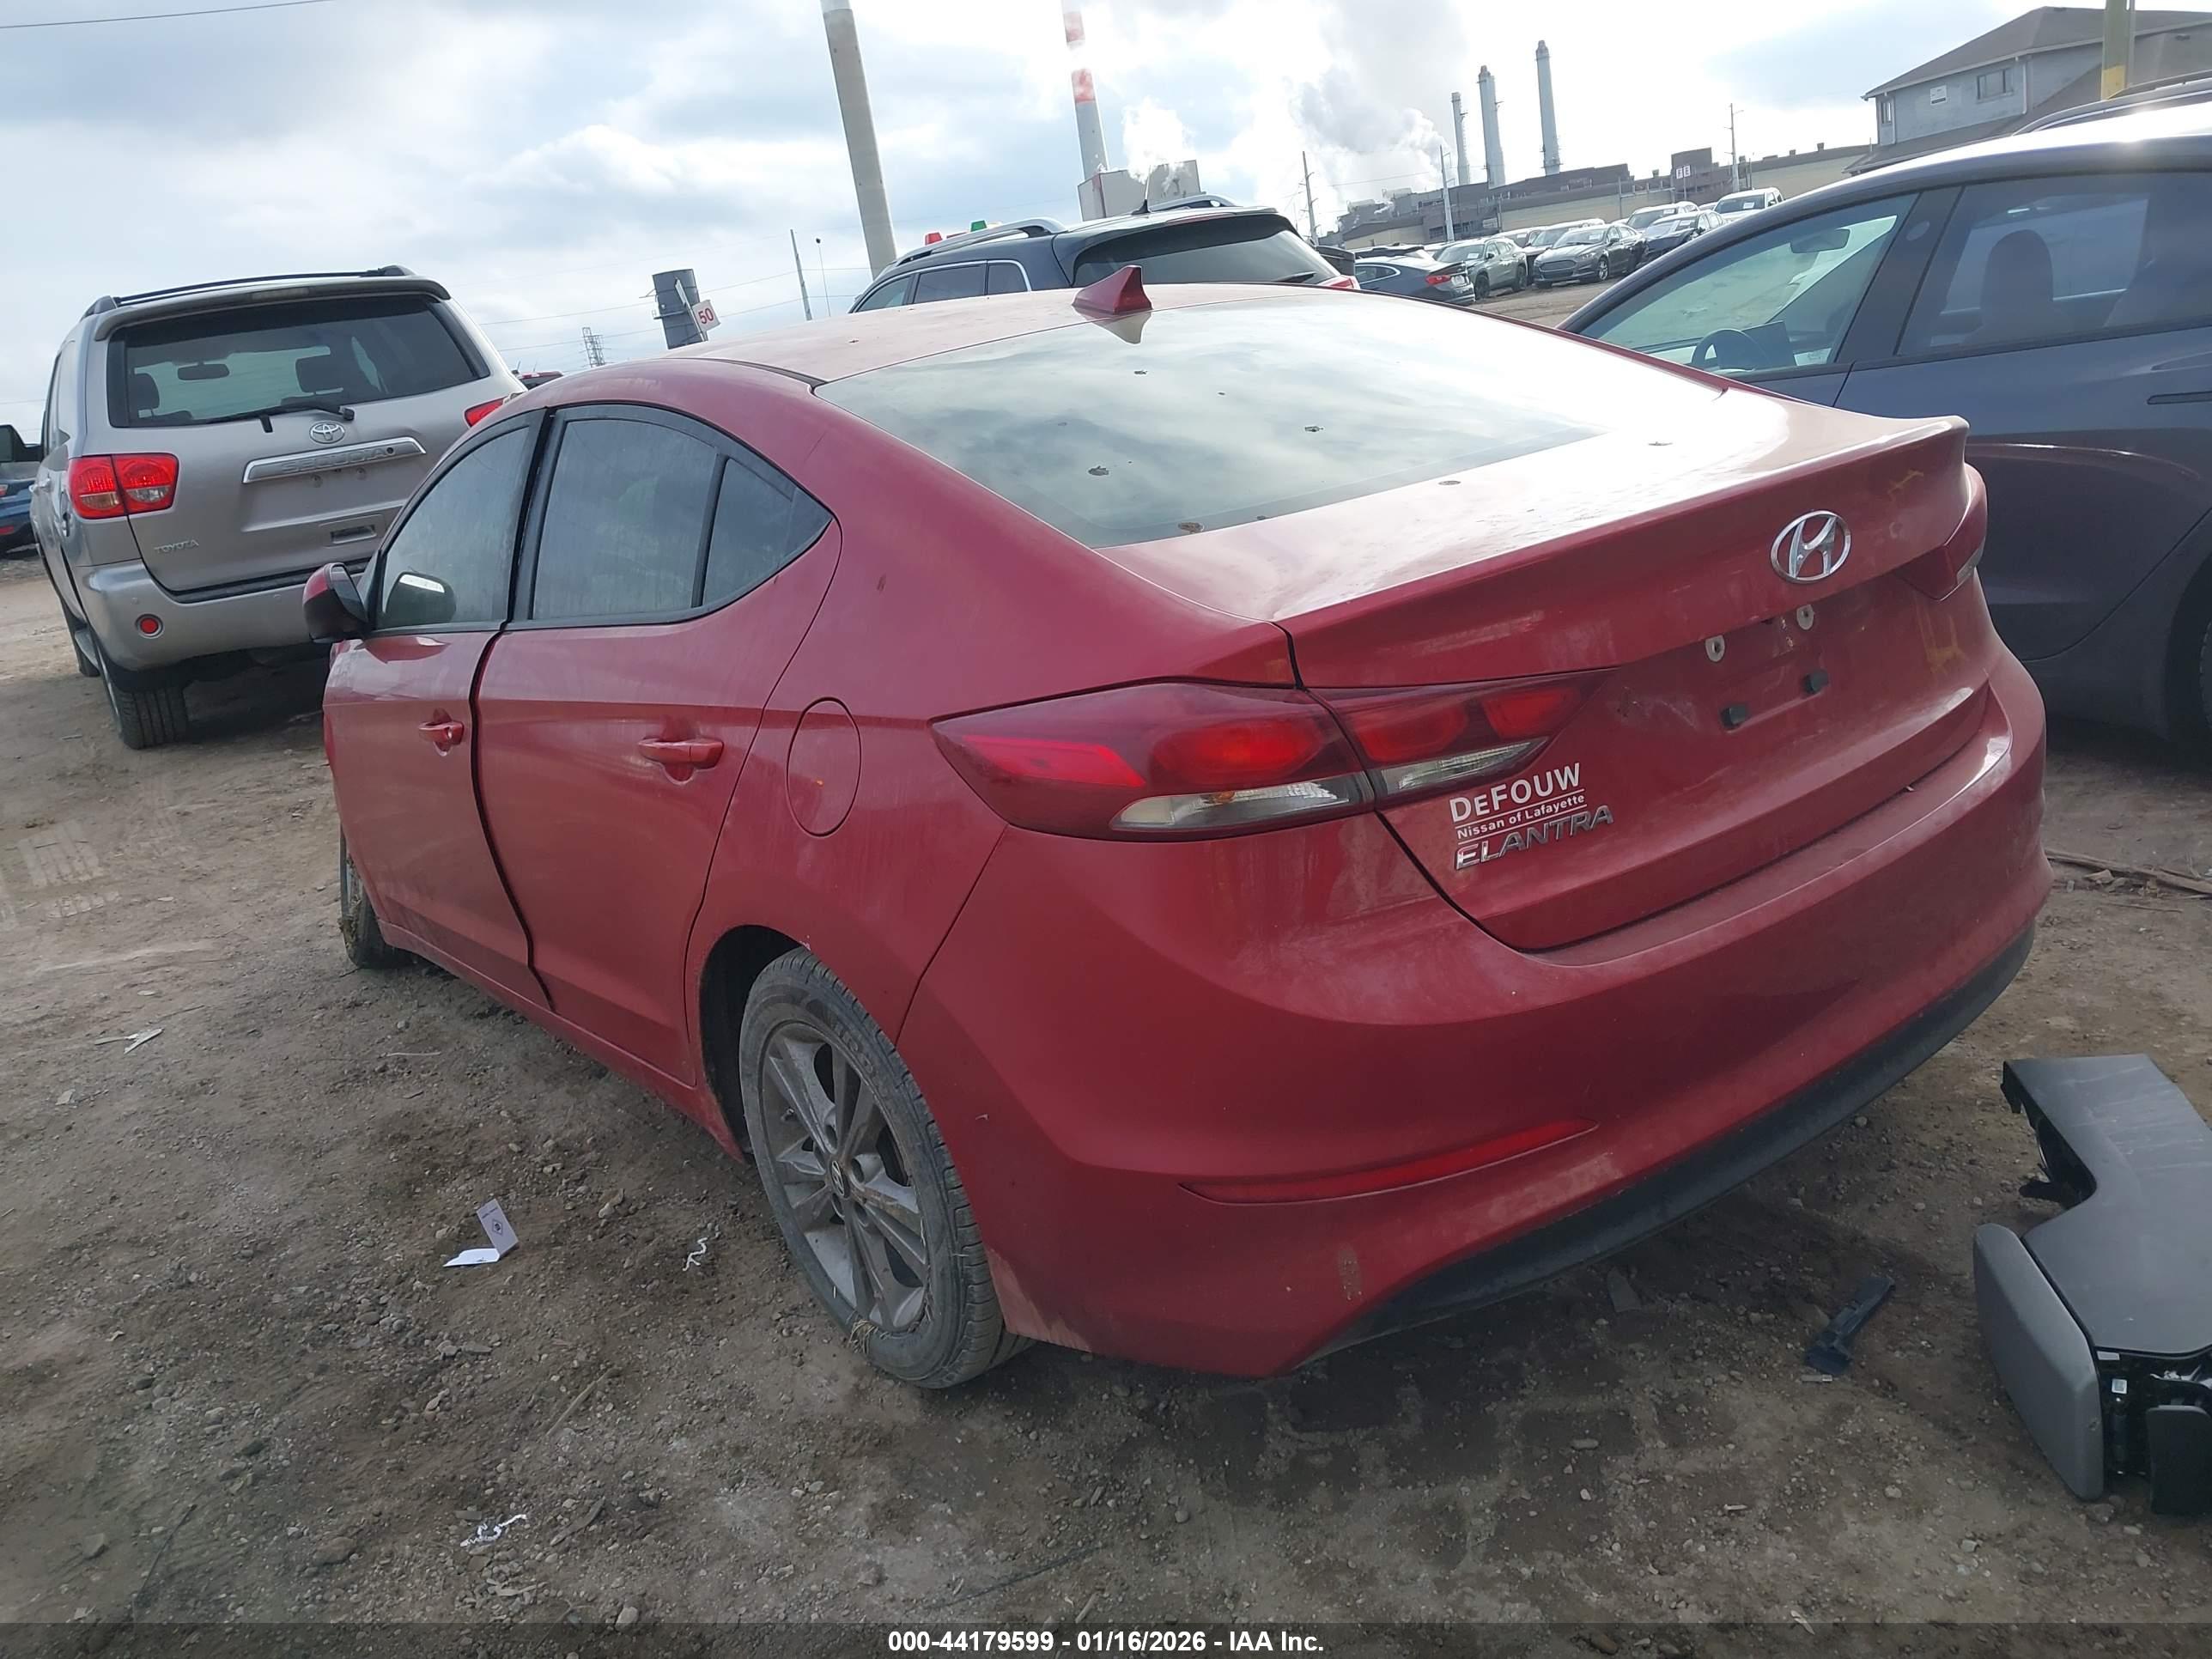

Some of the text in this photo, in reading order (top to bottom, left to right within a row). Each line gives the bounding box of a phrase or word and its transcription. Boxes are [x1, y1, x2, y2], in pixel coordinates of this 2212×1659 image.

[698, 308, 714, 324] 50
[154, 539, 199, 555] TOYOTA
[1457, 795, 1585, 840] Nissan of Lafayette
[1454, 805, 1614, 871] ELANTRA
